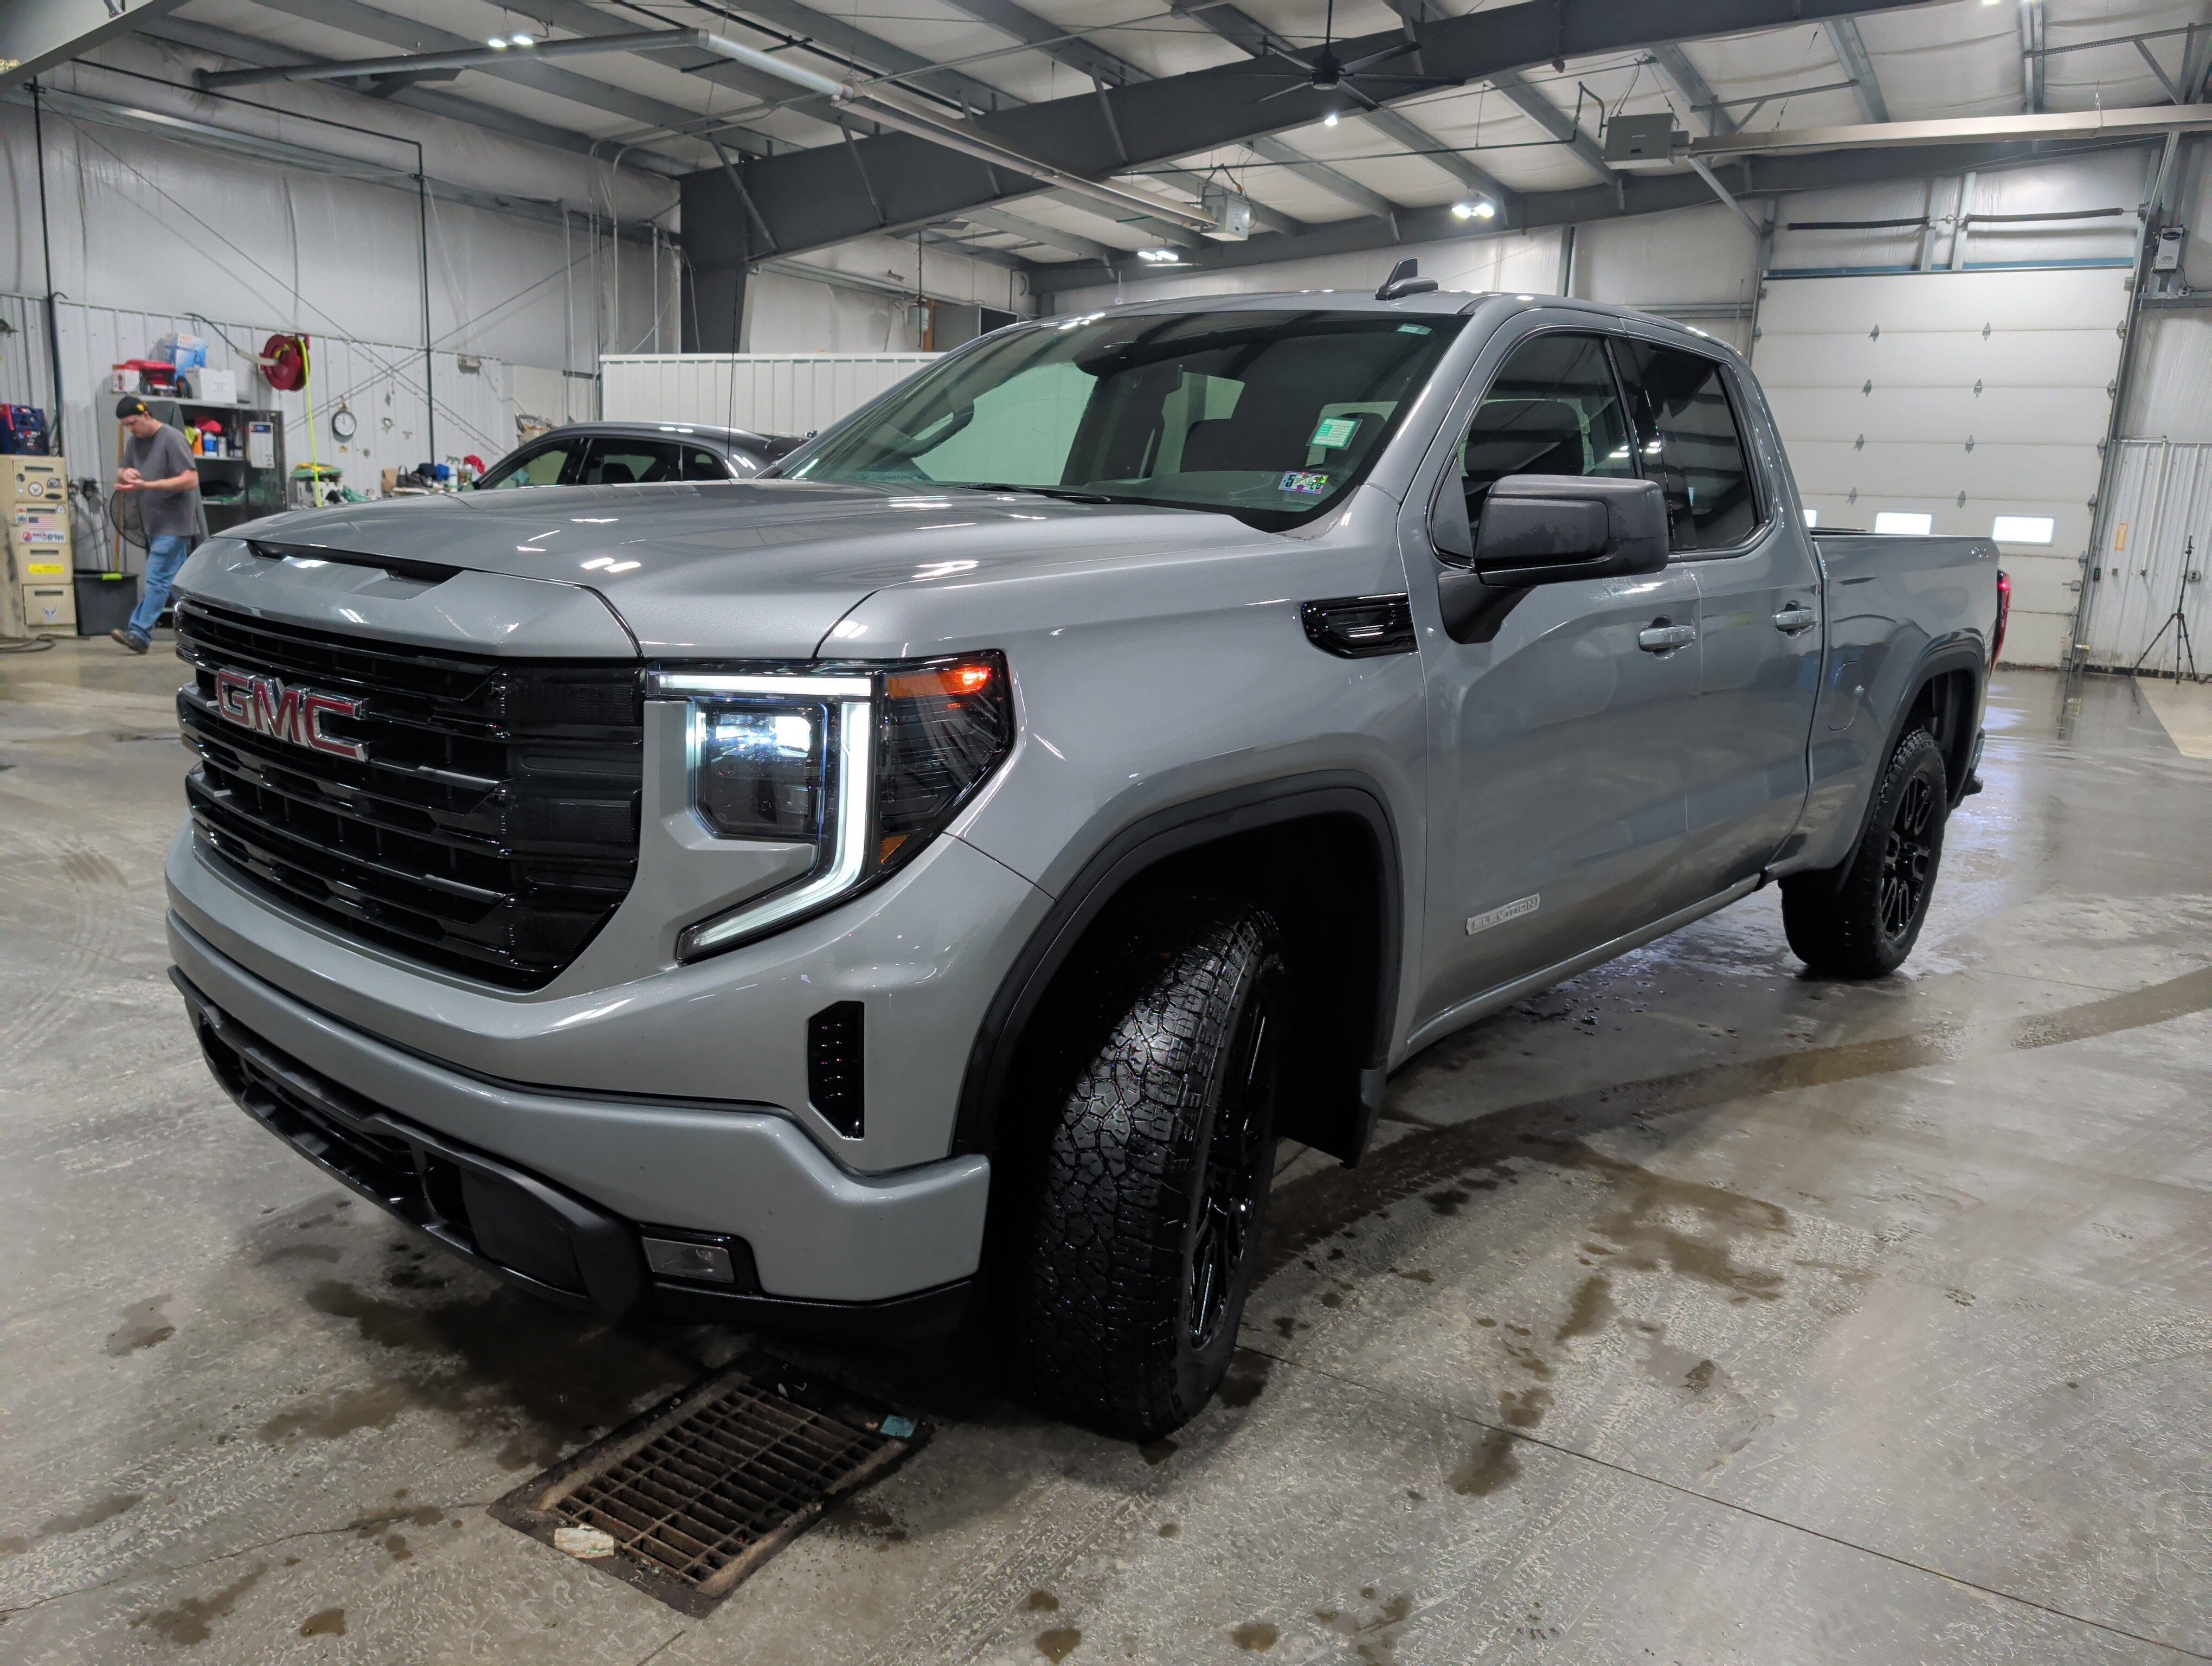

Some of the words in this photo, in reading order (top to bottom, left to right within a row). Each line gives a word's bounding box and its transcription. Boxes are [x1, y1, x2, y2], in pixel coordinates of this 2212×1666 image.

[1285, 474, 1296, 488] 5
[216, 667, 366, 762] GMC
[1472, 899, 1536, 929] ELEVATION
